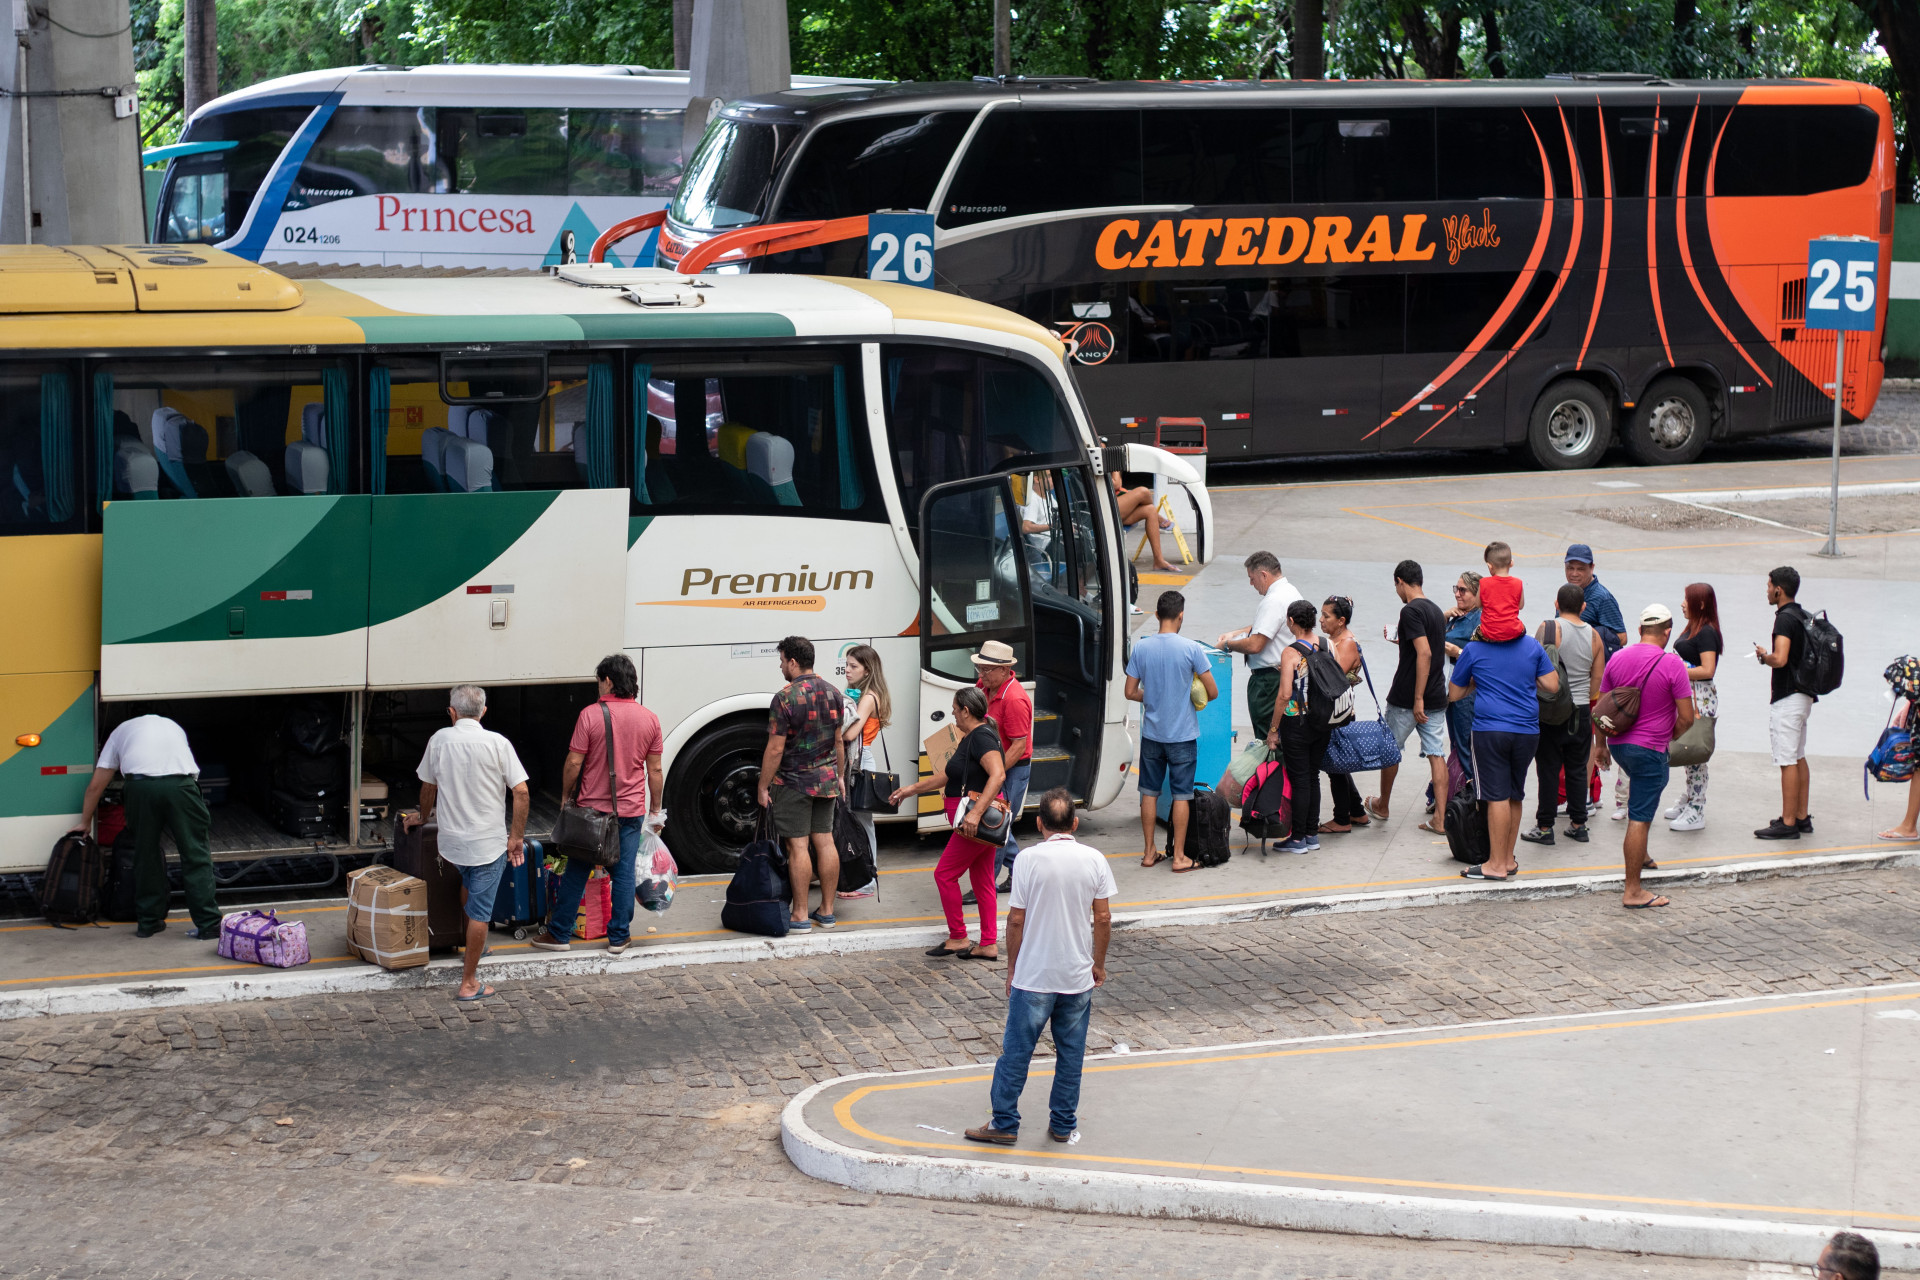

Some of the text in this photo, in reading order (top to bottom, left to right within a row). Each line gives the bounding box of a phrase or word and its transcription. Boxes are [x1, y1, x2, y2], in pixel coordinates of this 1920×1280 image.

[306, 188, 354, 197] Marcopolo
[374, 194, 536, 234] Princesa
[958, 204, 1008, 214] Marcopolo
[283, 225, 341, 245] 024 1206
[1095, 207, 1501, 270] CATEDRAL Black
[870, 232, 933, 282] 26
[1808, 258, 1875, 312] 25
[680, 564, 874, 596] Premium
[757, 599, 817, 607] REFRIGERADO
